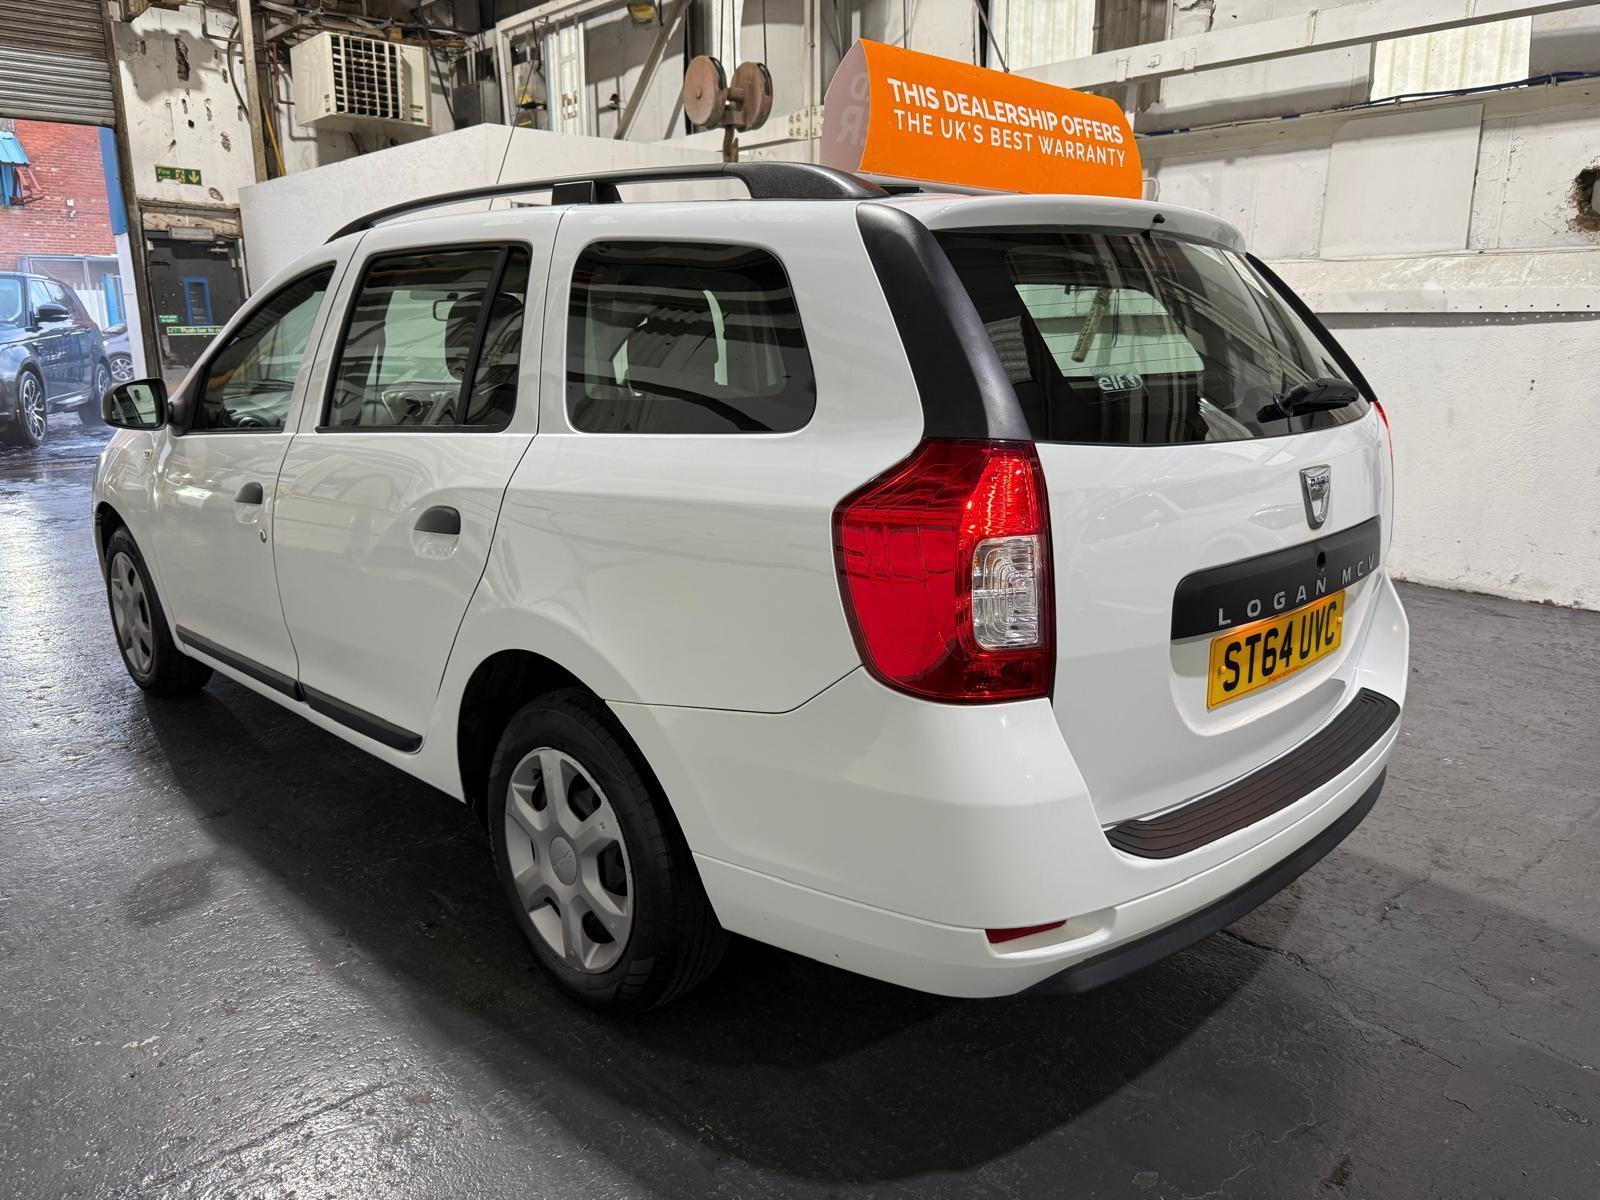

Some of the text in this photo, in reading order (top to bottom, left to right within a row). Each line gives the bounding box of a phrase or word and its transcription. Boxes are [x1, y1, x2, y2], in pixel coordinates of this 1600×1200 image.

[887, 77, 940, 110] THIS
[942, 89, 1058, 132] DEALERSHIP
[1061, 114, 1124, 145] OFFERS
[893, 108, 934, 136] THE
[941, 117, 984, 144] UK'S
[990, 126, 1033, 152] BEST
[1038, 135, 1126, 168] WARRANTY
[1218, 552, 1375, 627] LOGAN MCV
[1222, 600, 1338, 692] ST64 UVC
